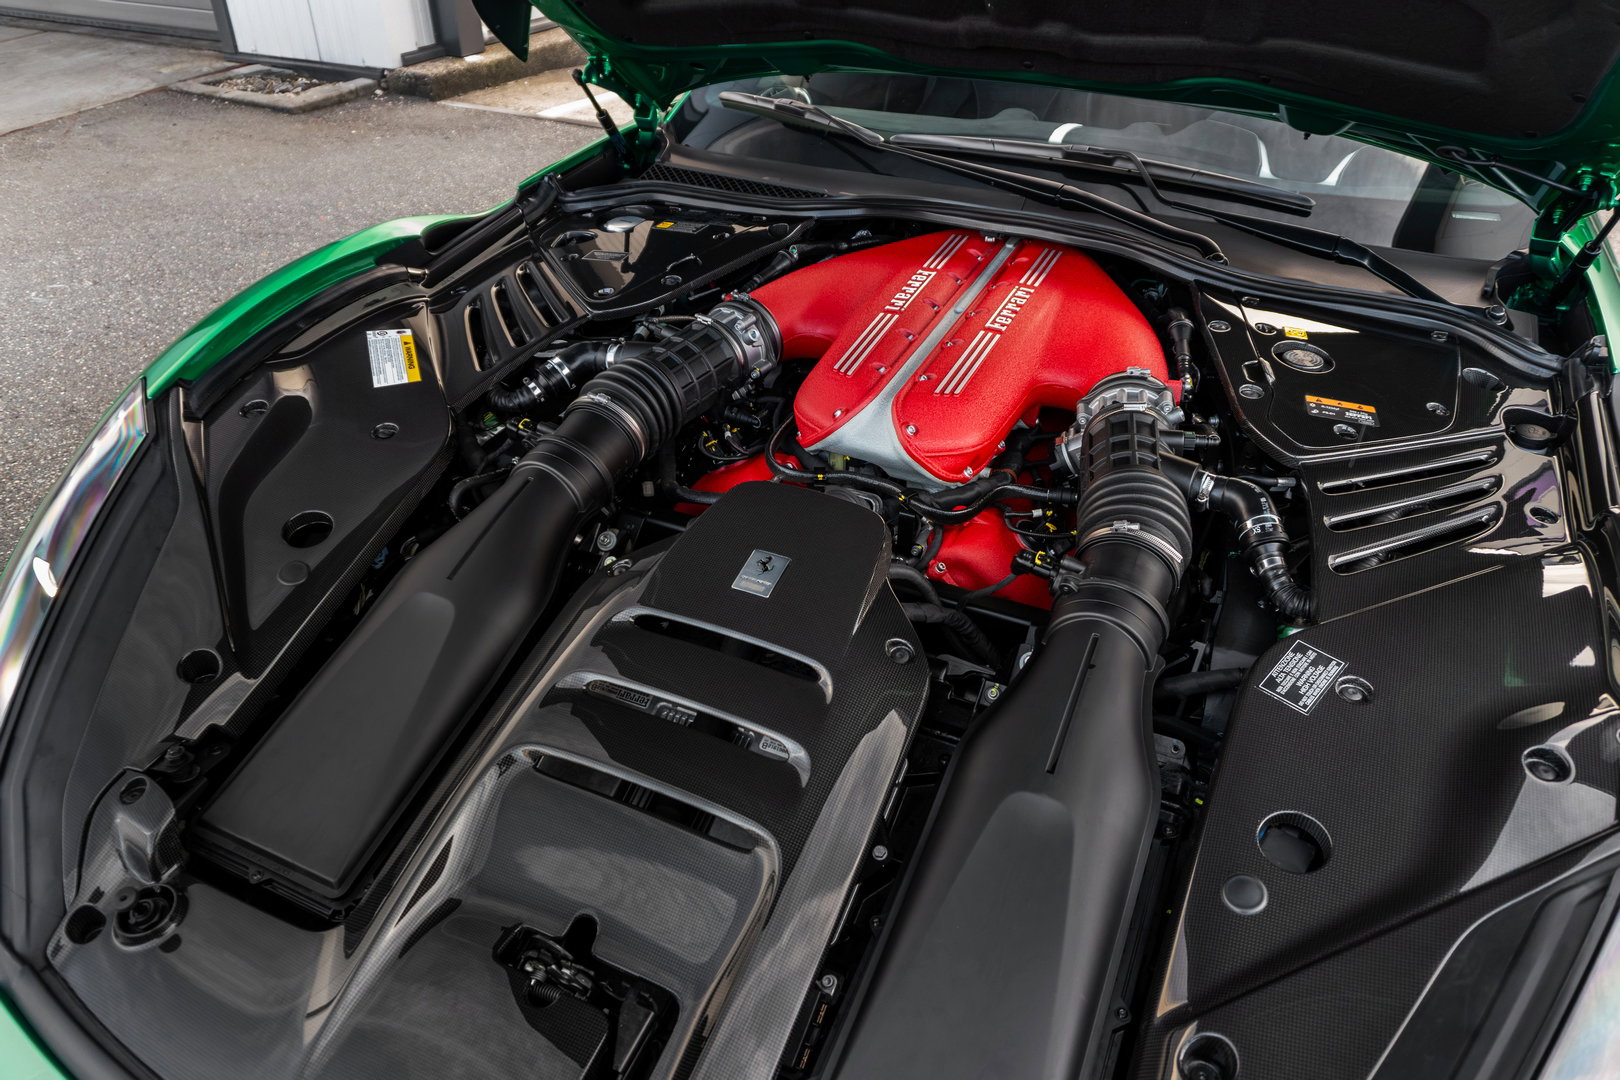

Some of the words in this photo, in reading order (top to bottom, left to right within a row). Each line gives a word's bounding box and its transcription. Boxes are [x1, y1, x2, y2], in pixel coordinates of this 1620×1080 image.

[885, 269, 937, 312] Ferrari
[985, 285, 1035, 332] Ferrari
[405, 347, 416, 369] WARNING
[1271, 651, 1296, 678] ATTENZIONE
[1275, 672, 1287, 683] ALTA
[1283, 652, 1304, 673] TENSIONE
[1296, 665, 1316, 687] WARNING
[1298, 682, 1311, 695] HIGH
[1308, 664, 1326, 683] VOLTAGE
[616, 690, 650, 708] Ferrari
